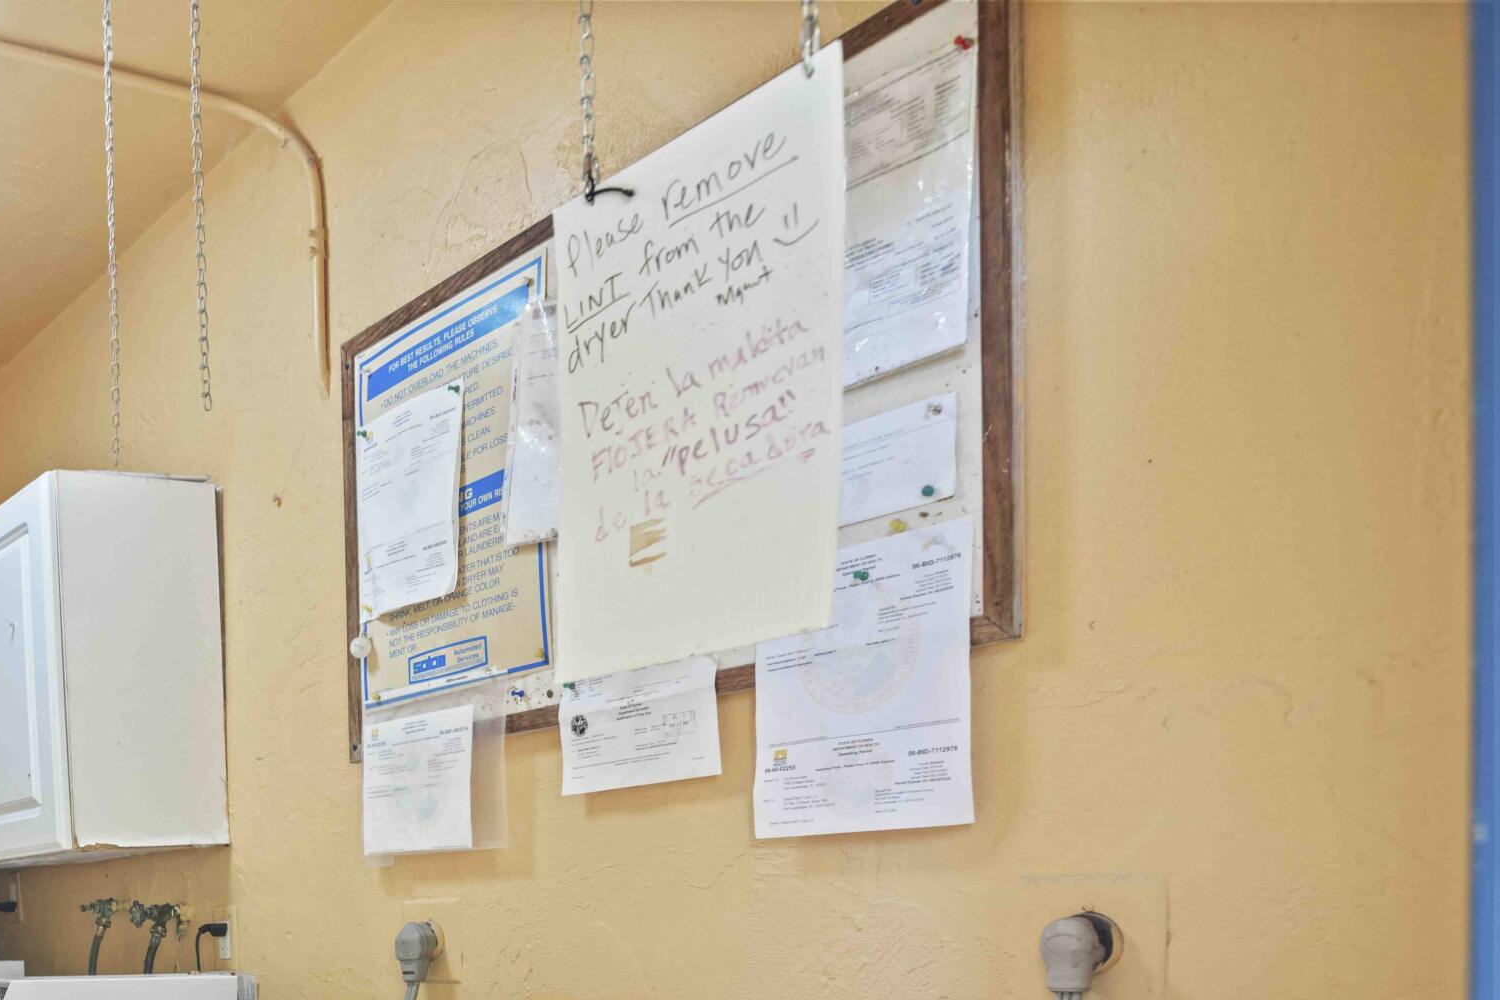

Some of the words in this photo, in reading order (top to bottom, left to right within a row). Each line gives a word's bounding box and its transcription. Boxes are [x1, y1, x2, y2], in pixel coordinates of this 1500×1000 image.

[567, 213, 643, 277] Please
[661, 132, 787, 220] remove
[564, 272, 629, 329] LINT
[639, 240, 700, 276] from
[709, 203, 765, 238] the
[569, 301, 636, 373] dryer
[639, 263, 713, 317] Thank
[388, 361, 400, 373] FOR
[400, 352, 414, 366] BEST
[443, 321, 467, 341] PLEASE
[468, 304, 498, 327] OBSERVE
[407, 360, 418, 372] THE
[419, 341, 453, 366] FOLLOWING
[454, 329, 475, 346] RULES
[408, 369, 443, 393] OVERLOAD
[445, 360, 460, 374] THE
[472, 443, 488, 458] FOR
[478, 491, 493, 504] OWN
[478, 515, 492, 527] ARE
[478, 527, 492, 538] ARE
[476, 555, 495, 568] THAT
[495, 553, 502, 561] IS
[502, 546, 520, 558] TOO
[462, 571, 486, 585] DRYER
[488, 564, 504, 577] MAY
[402, 621, 418, 633] LOSS
[420, 616, 431, 627] OR
[431, 607, 459, 624] DAMAGE
[461, 604, 471, 614] TO
[472, 591, 509, 610] CLOTHING
[510, 588, 518, 598] IS
[388, 637, 401, 649] NOT
[403, 633, 416, 644] THE
[416, 617, 469, 640] RESPONSIBILITY
[470, 612, 481, 623] OF
[388, 646, 405, 658] MENT
[456, 652, 480, 664] Services
